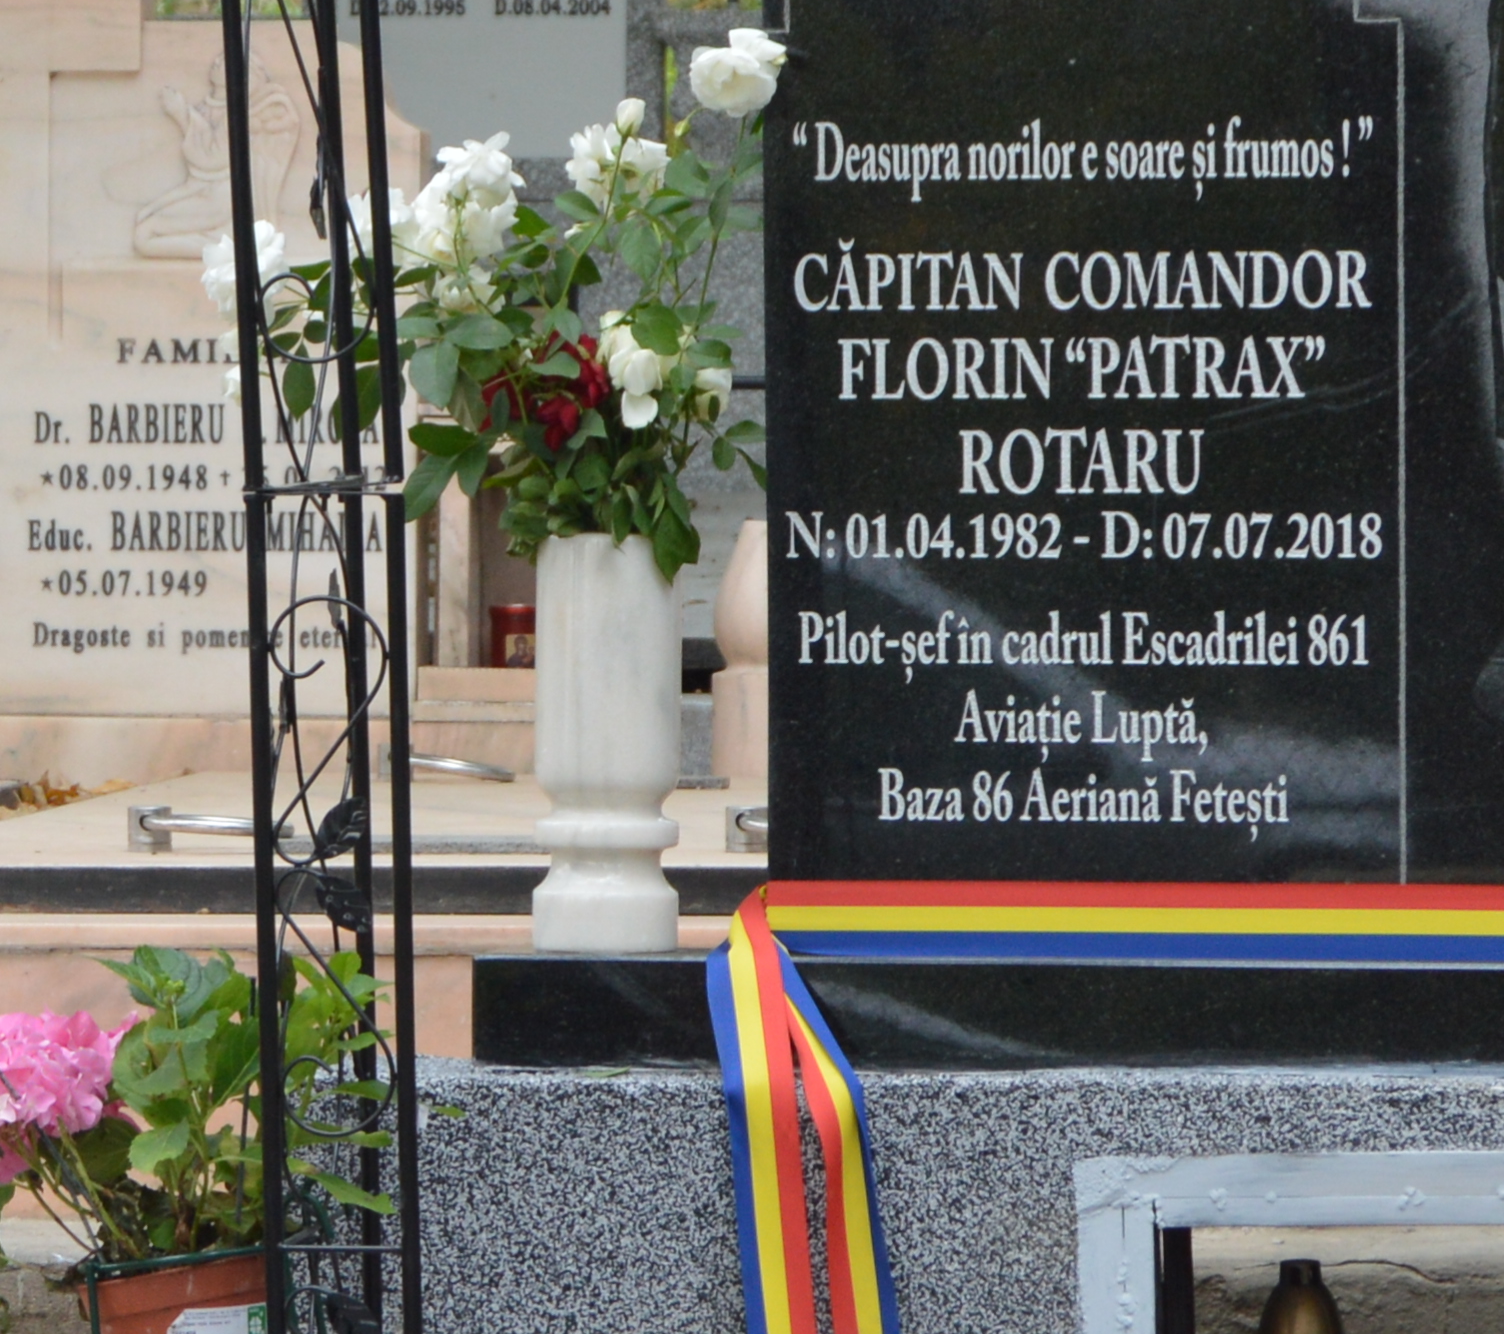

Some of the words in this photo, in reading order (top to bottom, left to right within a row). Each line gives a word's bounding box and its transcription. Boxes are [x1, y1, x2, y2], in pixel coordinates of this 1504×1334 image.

[968, 119, 1077, 180] norilor
[1082, 141, 1098, 180] e
[1106, 141, 1185, 180] soare
[1193, 123, 1217, 202] și
[793, 237, 1023, 312] CĂPITAN
[1044, 249, 1372, 311] COMANDOR
[838, 336, 1054, 399] FLORIN
[34, 411, 70, 444] Dr.
[89, 403, 225, 444] BARBIERU
[958, 428, 1204, 496] ROTARU
[27, 518, 92, 552] Educ.
[111, 511, 247, 552] BARBIERU
[267, 510, 383, 552] MIHAA
[785, 511, 836, 560] N:
[846, 512, 1062, 560] 01.04.1982
[1101, 511, 1153, 560] D:
[1162, 511, 1384, 560] 07.07.2018
[58, 570, 208, 598] 05.07.1949
[32, 621, 130, 653] Dragoste
[147, 621, 165, 648] si
[181, 626, 283, 654] pomene
[798, 609, 955, 685] Pilot-șef
[957, 621, 993, 666] în
[1001, 610, 1113, 667] cadrul
[1122, 610, 1301, 667] Escadrilei
[1307, 614, 1370, 667] 861
[954, 690, 1083, 762] Aviație
[1091, 690, 1209, 762] Luptă,
[878, 767, 965, 824] Baza
[971, 769, 1014, 824] 86
[1020, 767, 1162, 824] Aeriană
[1170, 770, 1291, 842] Fetești
